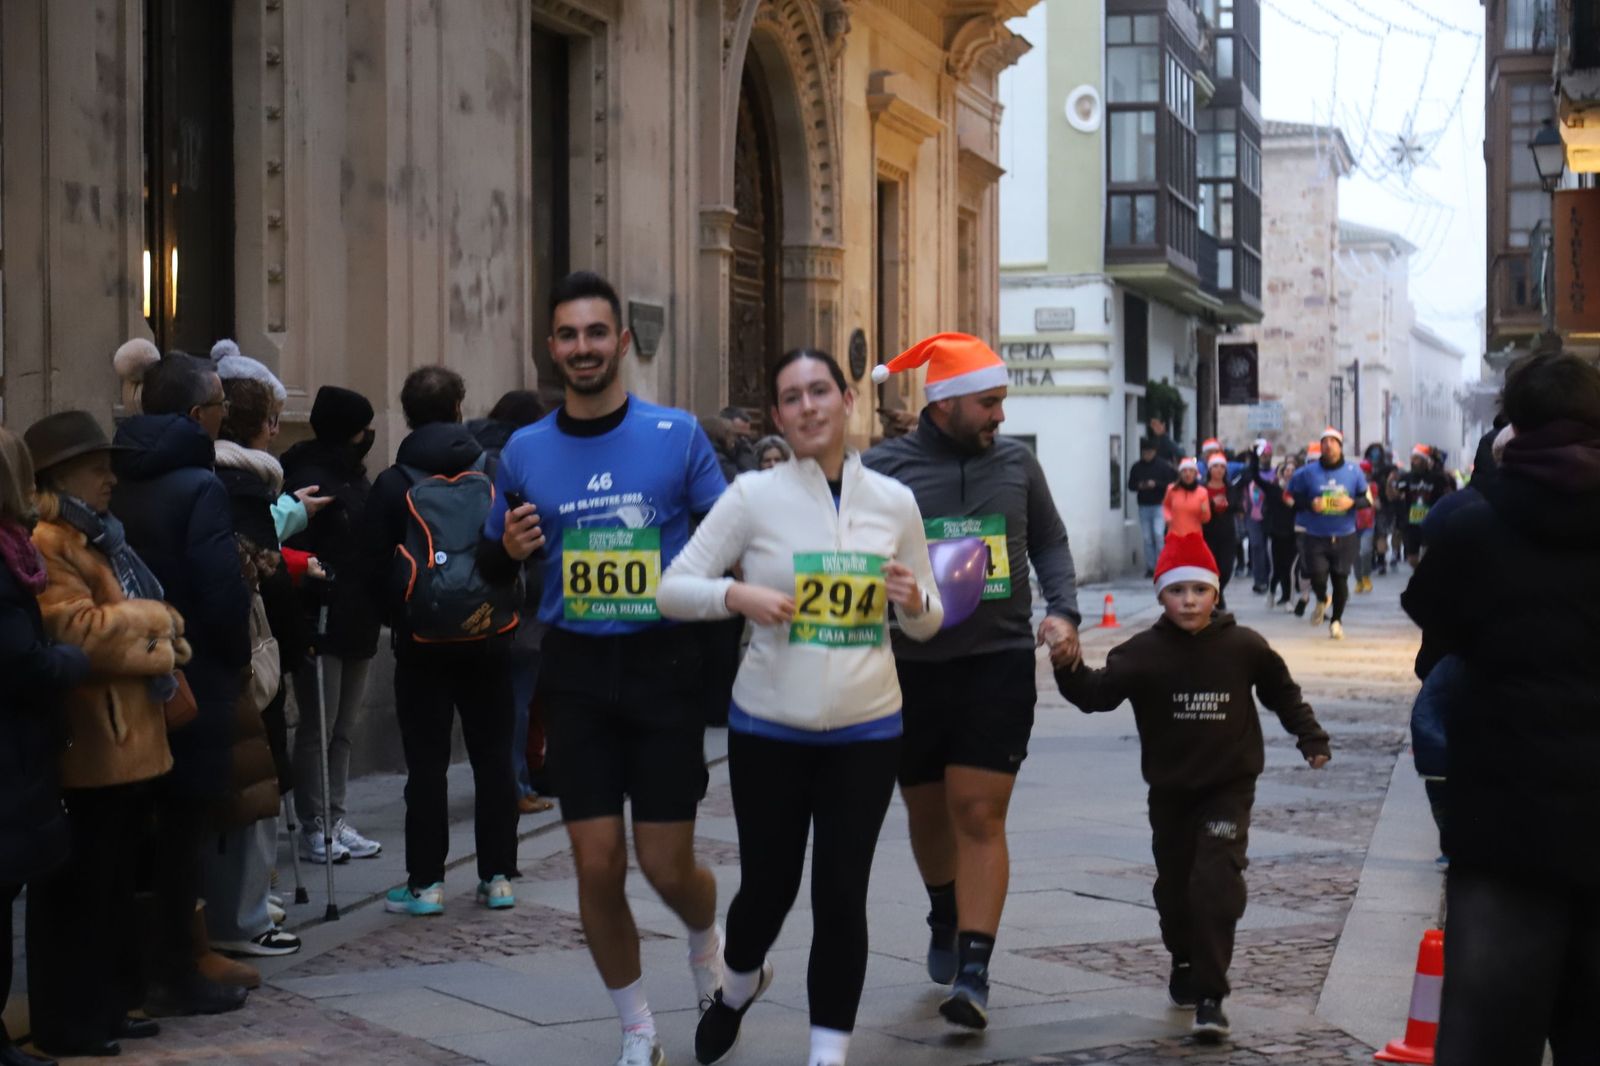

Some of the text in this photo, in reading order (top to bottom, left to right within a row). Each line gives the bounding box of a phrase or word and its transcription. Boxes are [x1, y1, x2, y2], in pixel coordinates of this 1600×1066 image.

[586, 472, 613, 492] 46
[559, 501, 575, 515] SAN
[577, 495, 620, 510] SILVESTRE
[570, 560, 647, 595] 860
[798, 578, 877, 618] 294
[591, 602, 656, 616] CAJA RURAL
[818, 627, 877, 643] CAJA RURAL
[1173, 692, 1230, 702] LOS ANGELES
[1185, 702, 1218, 711] LAKERS
